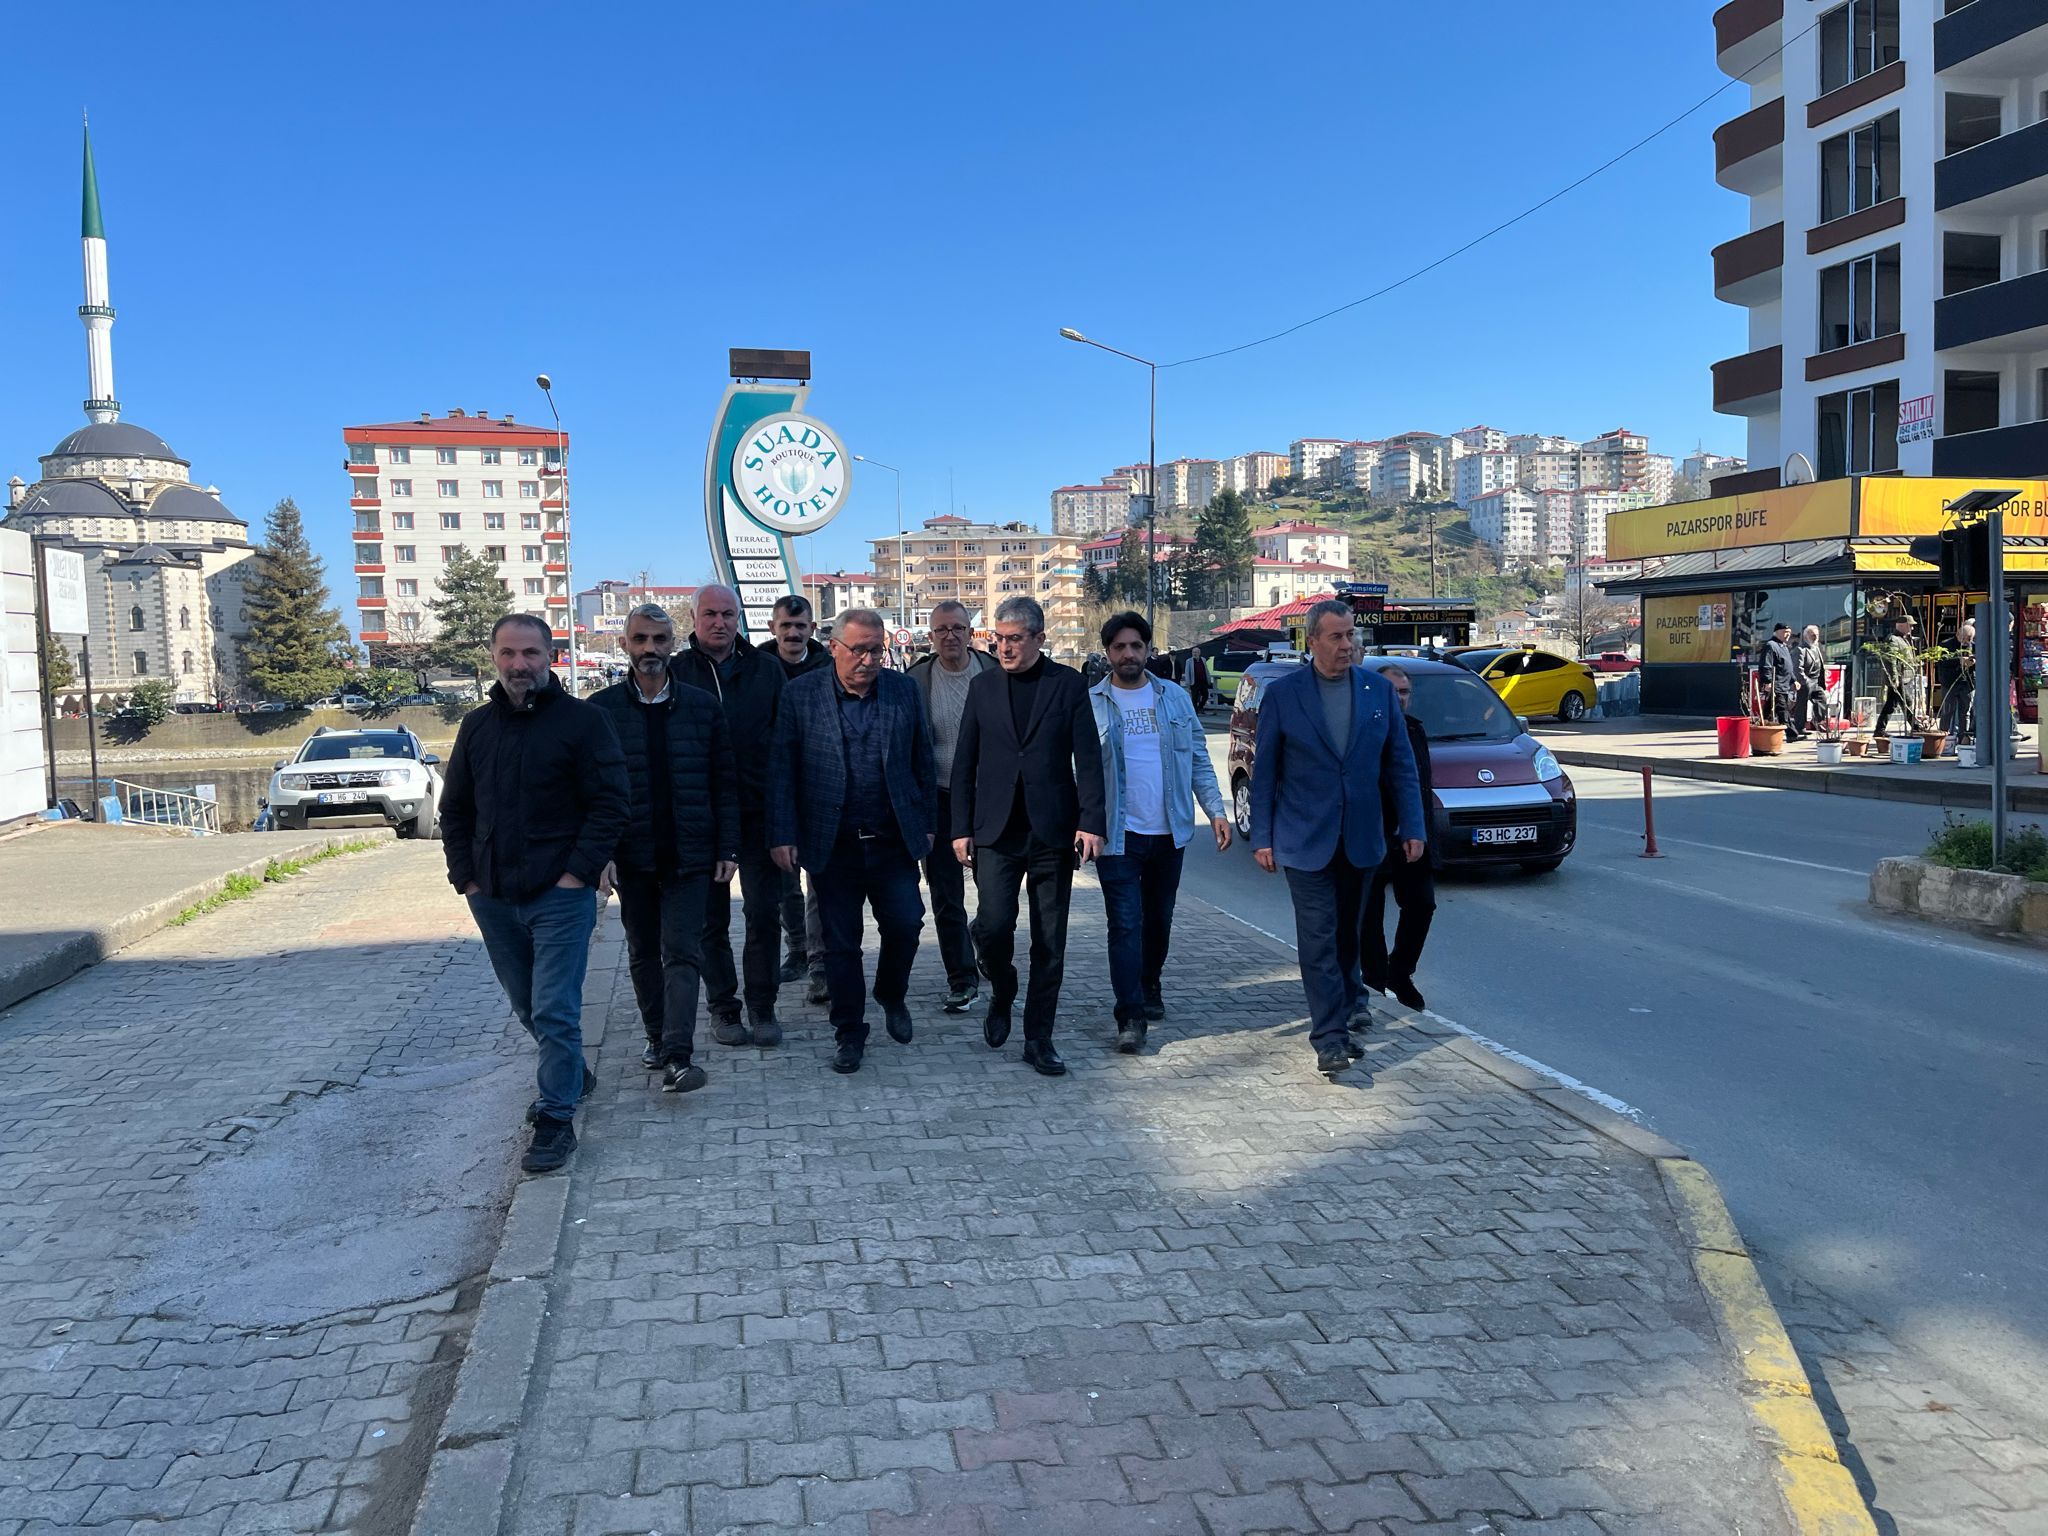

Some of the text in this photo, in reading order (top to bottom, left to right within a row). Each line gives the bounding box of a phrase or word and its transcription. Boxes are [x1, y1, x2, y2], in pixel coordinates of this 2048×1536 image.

[1899, 397, 1933, 424] SATILIK
[744, 425, 837, 471] SUADA
[770, 449, 816, 466] BOUTIQUE
[753, 484, 838, 518] HOTEL
[1666, 508, 1768, 538] PAZARSPOR BÜFE
[1656, 616, 1700, 629] PAZARSPO
[1669, 630, 1692, 644] BÜFE
[1124, 708, 1148, 718] THE
[1477, 827, 1536, 841] 53 HC 237
